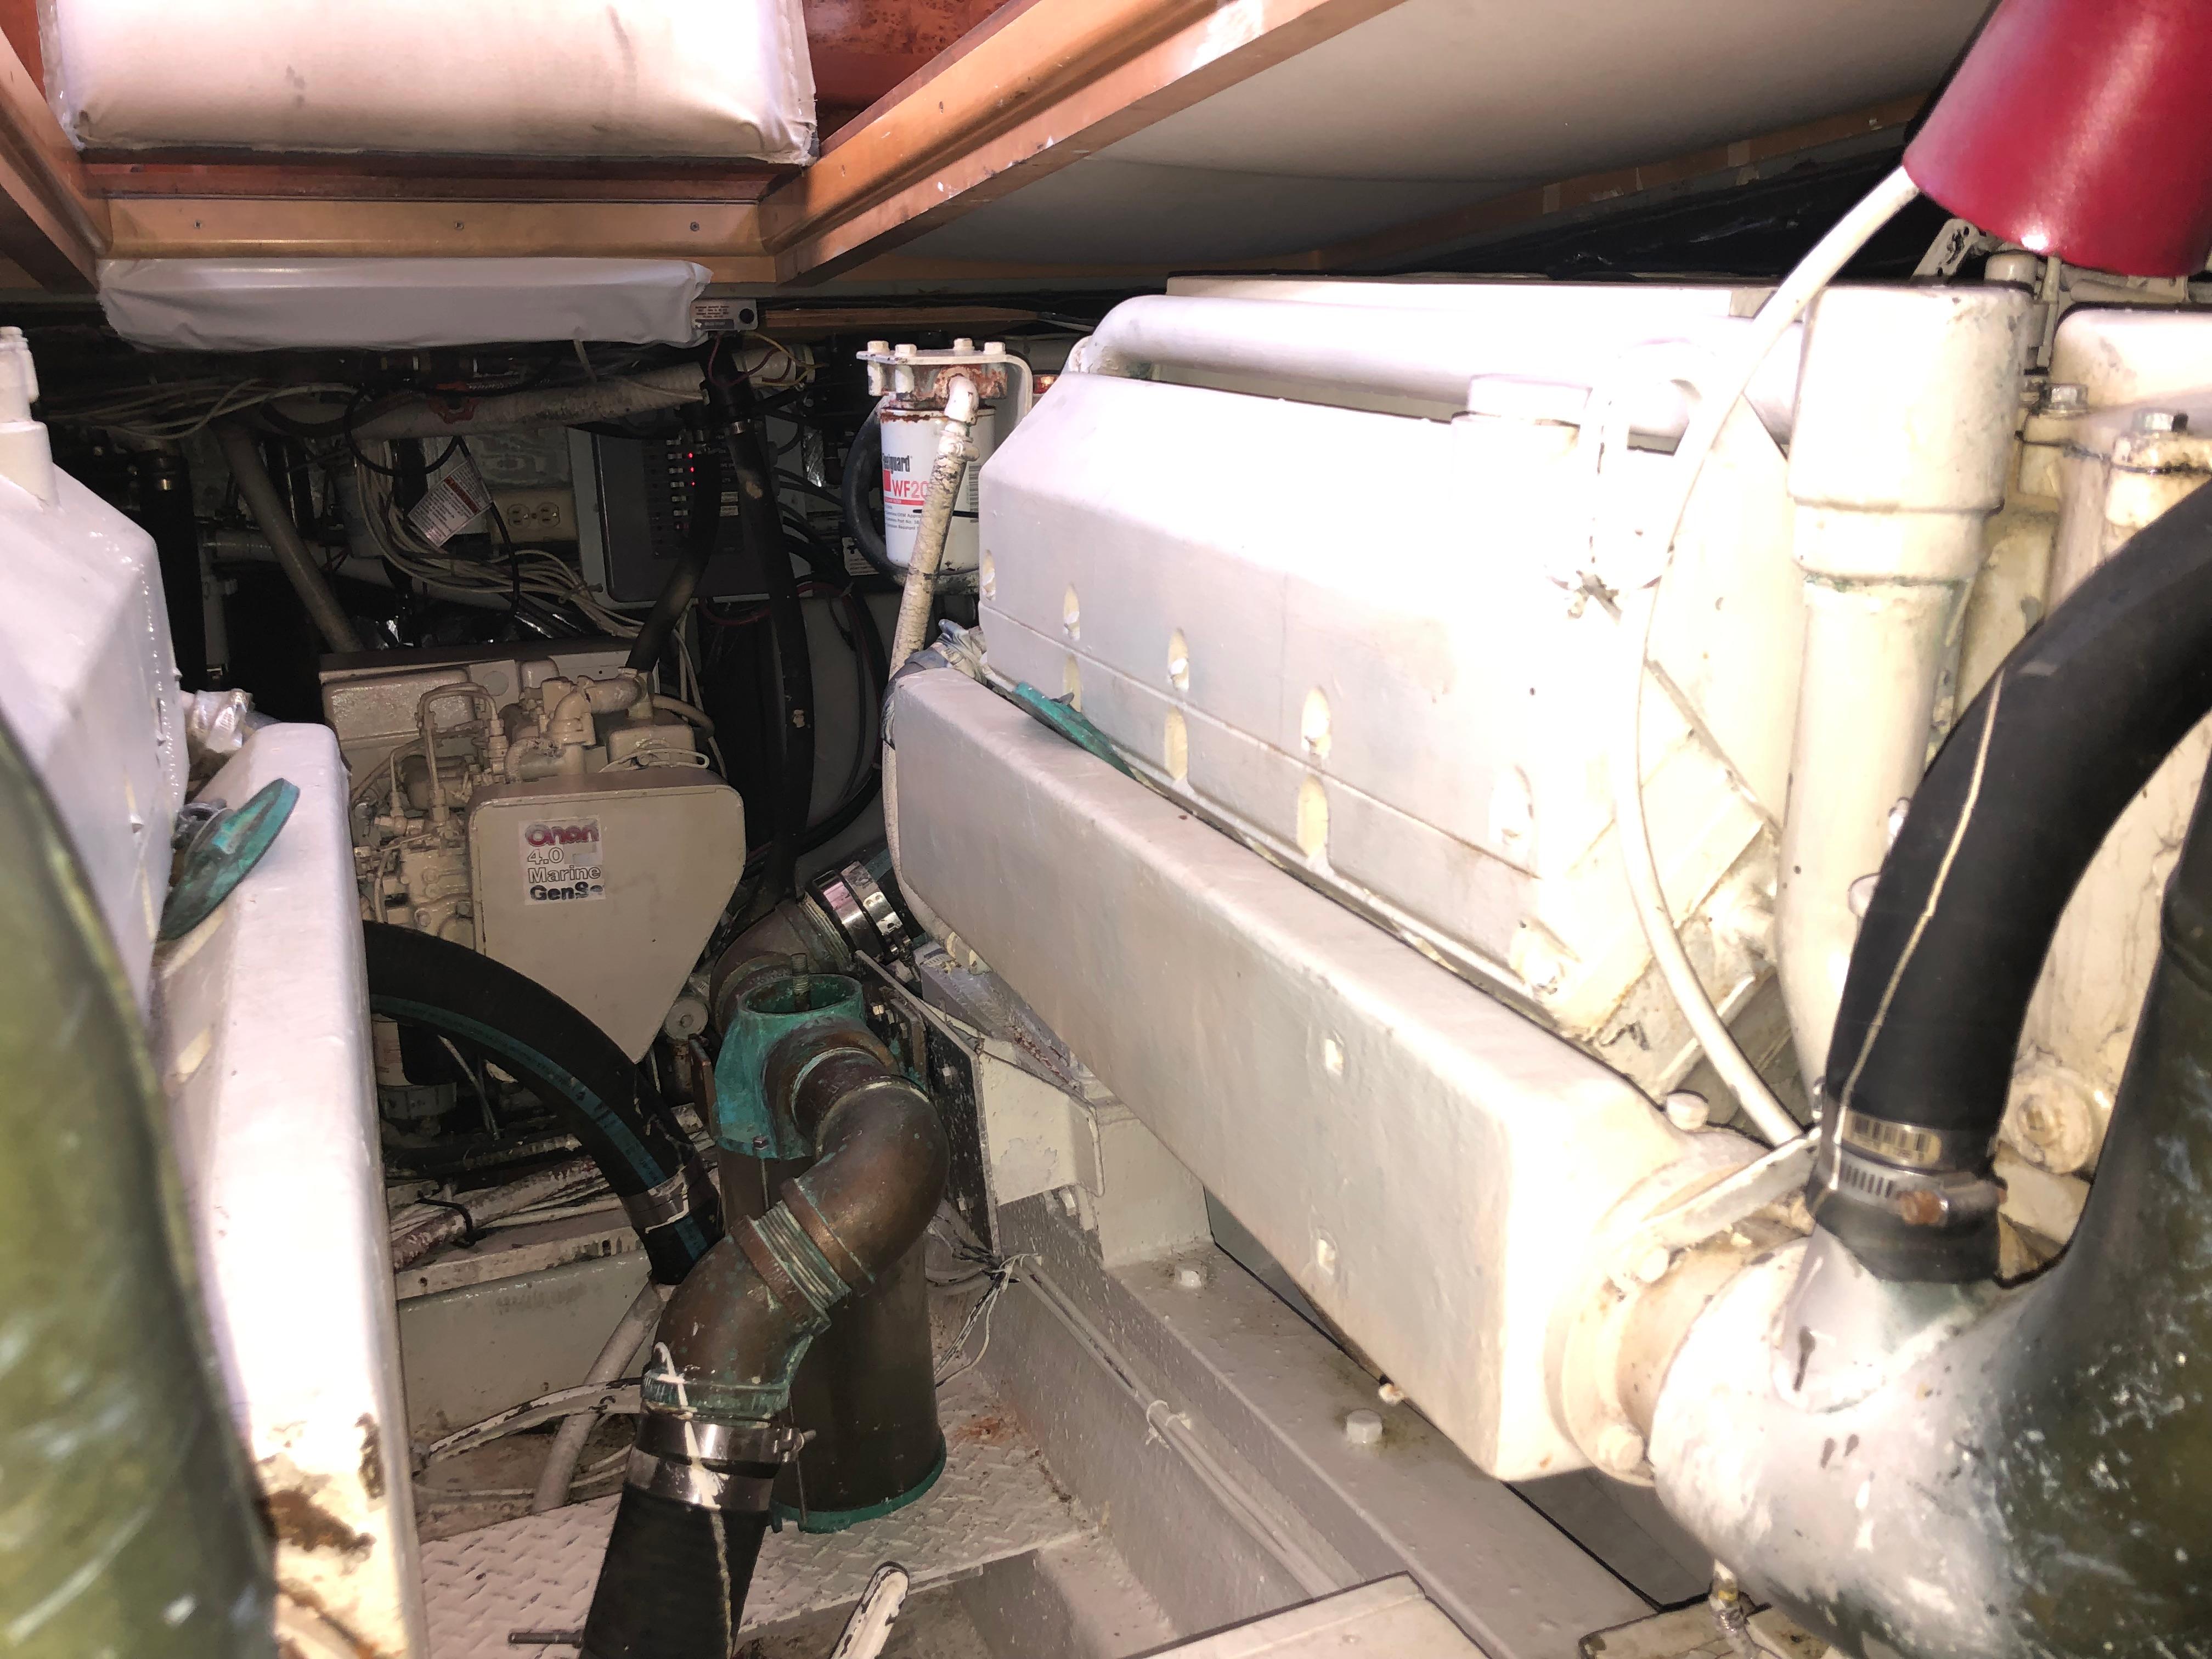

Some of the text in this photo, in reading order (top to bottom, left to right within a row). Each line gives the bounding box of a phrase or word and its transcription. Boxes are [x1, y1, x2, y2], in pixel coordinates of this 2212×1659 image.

[892, 479, 929, 498] WF20
[527, 847, 564, 865] 4.0
[528, 865, 601, 883] Marine
